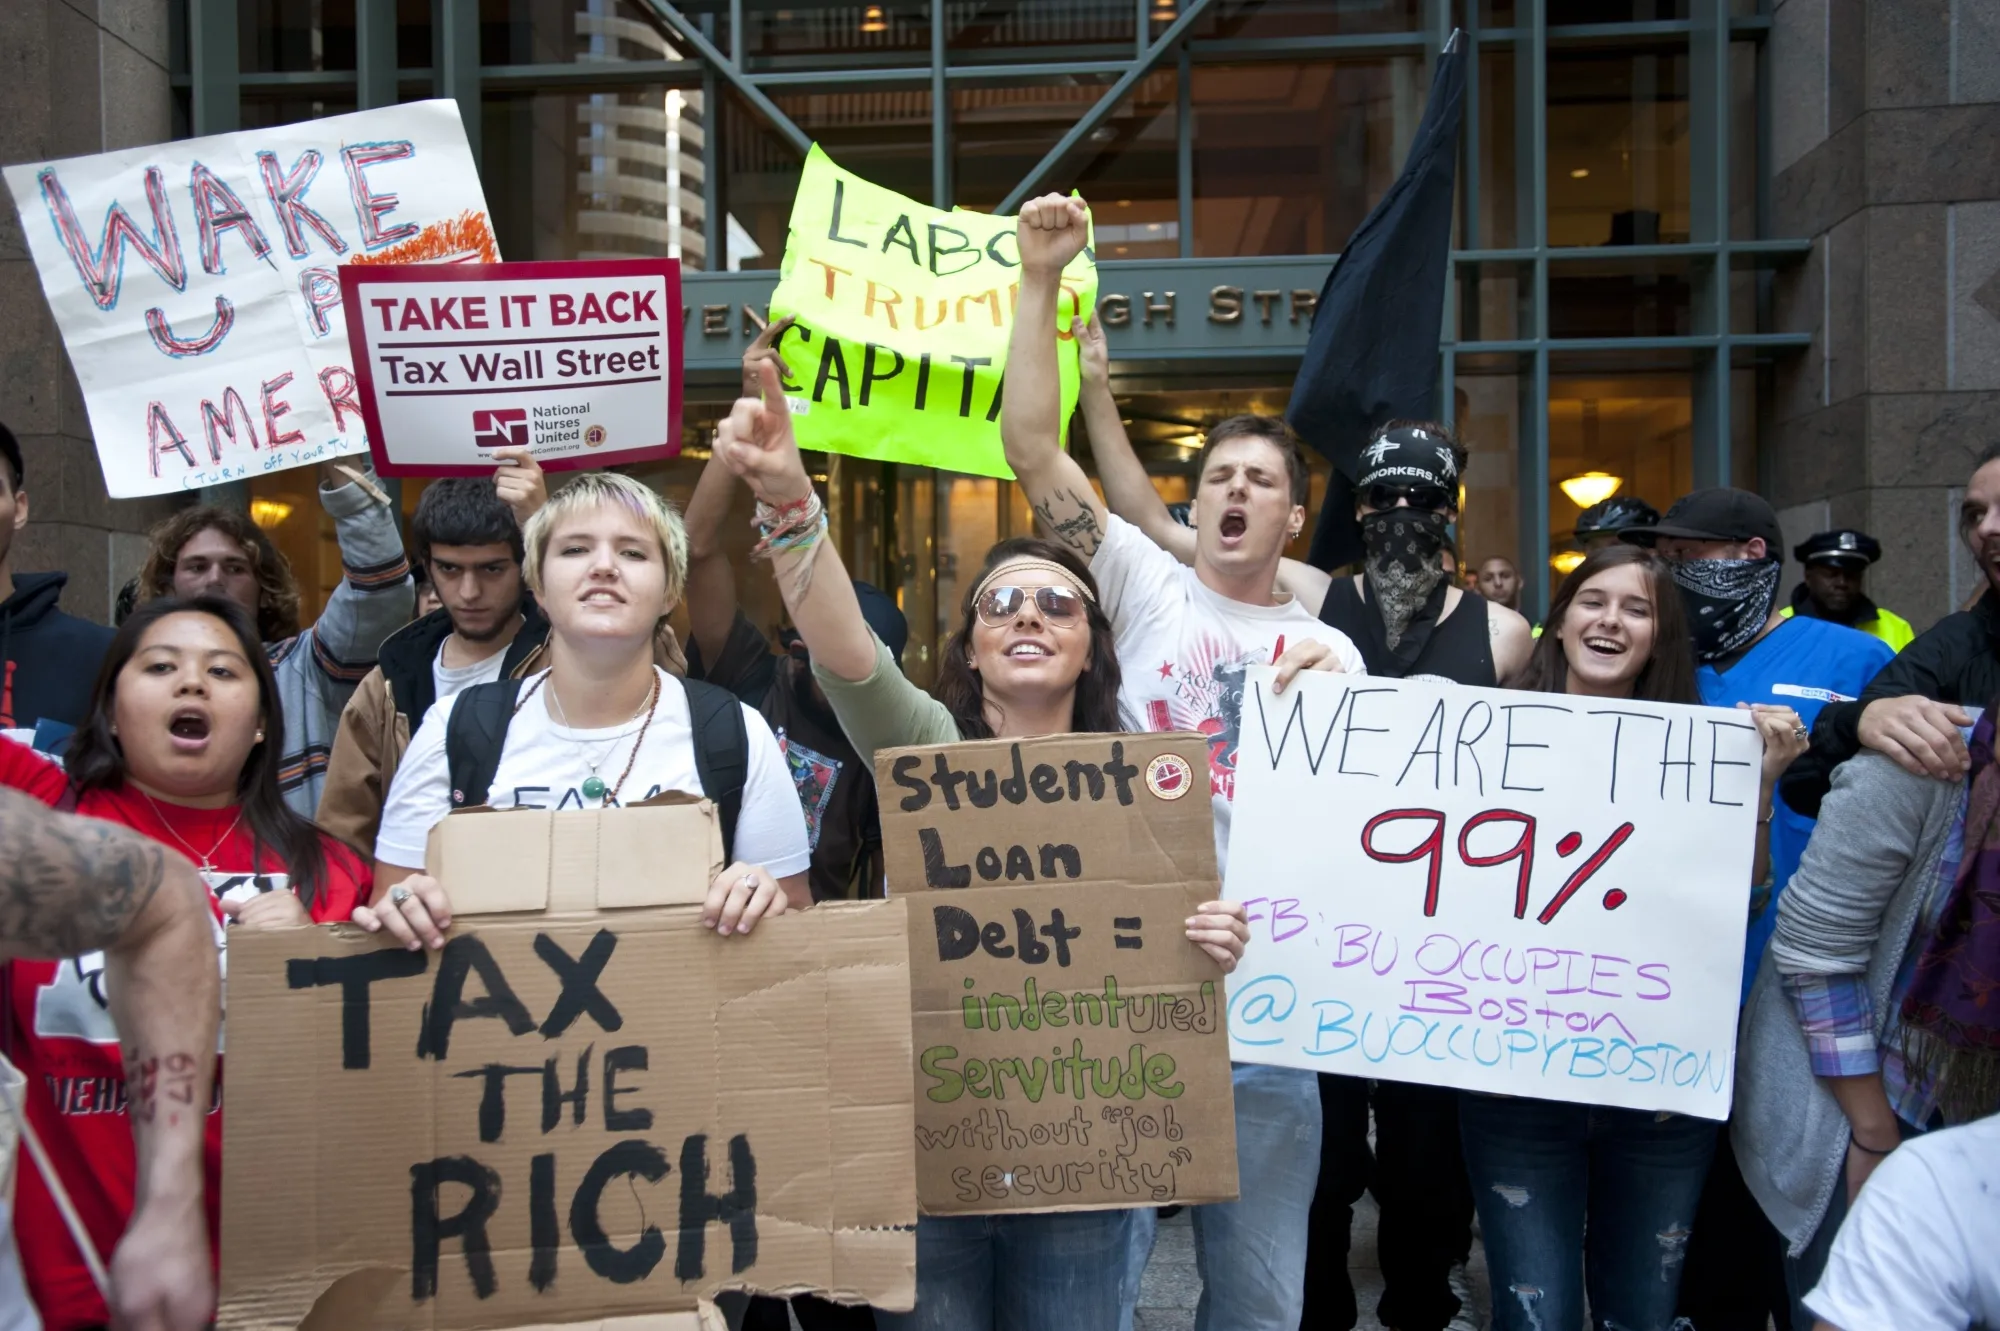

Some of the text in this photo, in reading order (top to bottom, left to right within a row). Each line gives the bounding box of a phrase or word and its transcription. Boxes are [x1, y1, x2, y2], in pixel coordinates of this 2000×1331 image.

[38, 141, 418, 310] WAKE
[829, 180, 1095, 276] LABO
[371, 290, 659, 331] TAKE IT BACK
[809, 258, 1085, 341] TRUM
[1208, 285, 1318, 324] STR
[380, 345, 660, 384] Tax Wall Street
[771, 323, 1004, 422] CAPIT
[147, 366, 361, 477] AMER
[533, 402, 590, 417] National
[534, 418, 580, 431] Nurses
[535, 429, 579, 444] United
[892, 741, 1139, 812] Student
[1255, 681, 1398, 777] WE
[1396, 697, 1574, 797] ARE
[1587, 710, 1756, 806] THE
[1361, 807, 1635, 925] 99%
[933, 905, 1081, 967] Debt
[1332, 923, 1399, 976] BU
[1415, 933, 1672, 1001] OCCUPIES
[286, 928, 623, 1070] TAX
[961, 975, 1217, 1034] indentured
[451, 1042, 653, 1143] THE
[920, 1038, 1184, 1103] Servitude
[915, 1106, 1092, 1151] without
[409, 1134, 759, 1300] RICH
